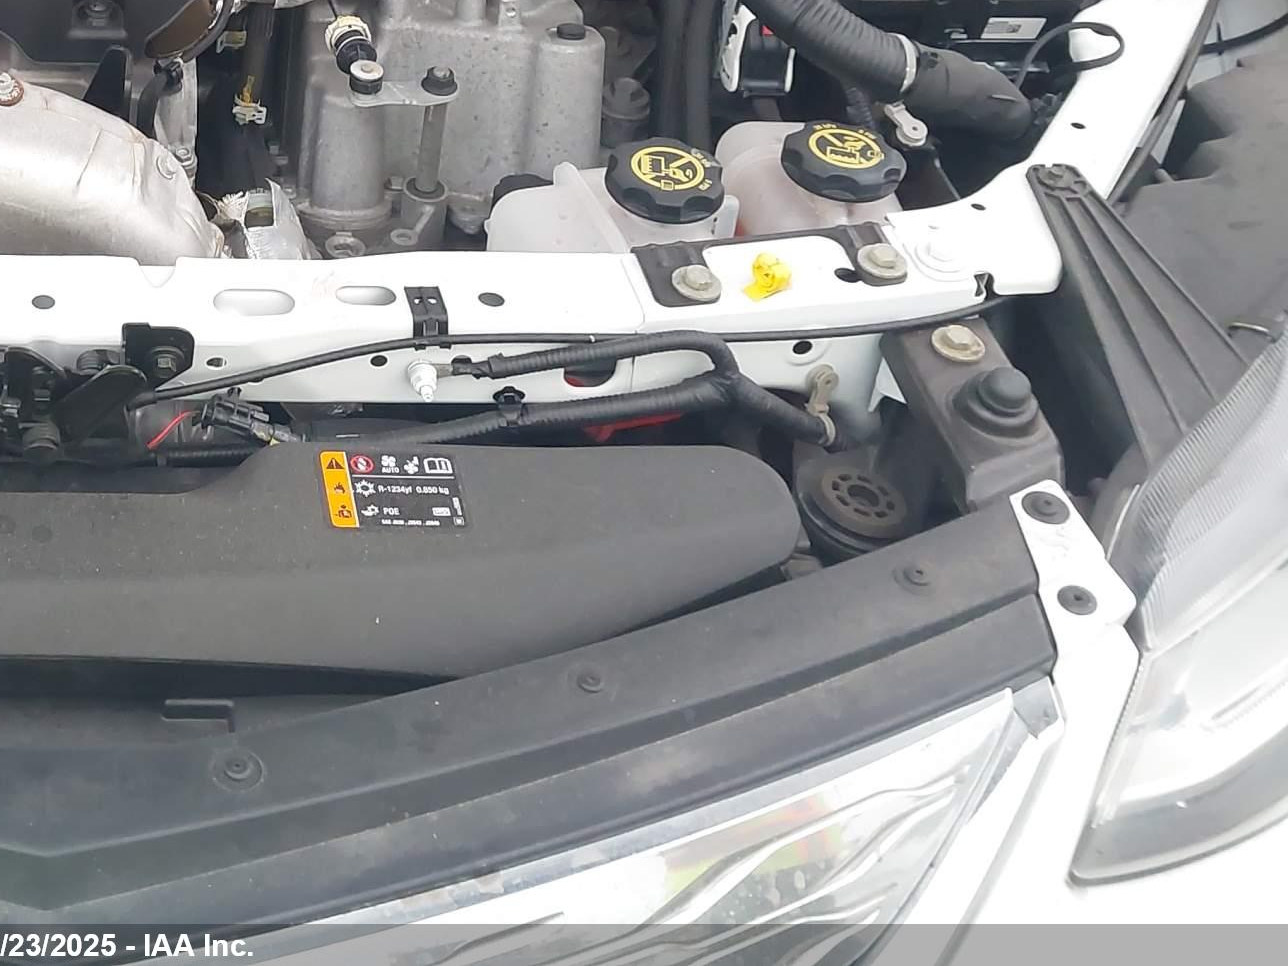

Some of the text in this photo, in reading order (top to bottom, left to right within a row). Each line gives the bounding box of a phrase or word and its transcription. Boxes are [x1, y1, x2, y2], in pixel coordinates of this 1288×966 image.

[381, 466, 400, 474] AUTO
[438, 486, 450, 495] kg
[382, 506, 401, 516] POE
